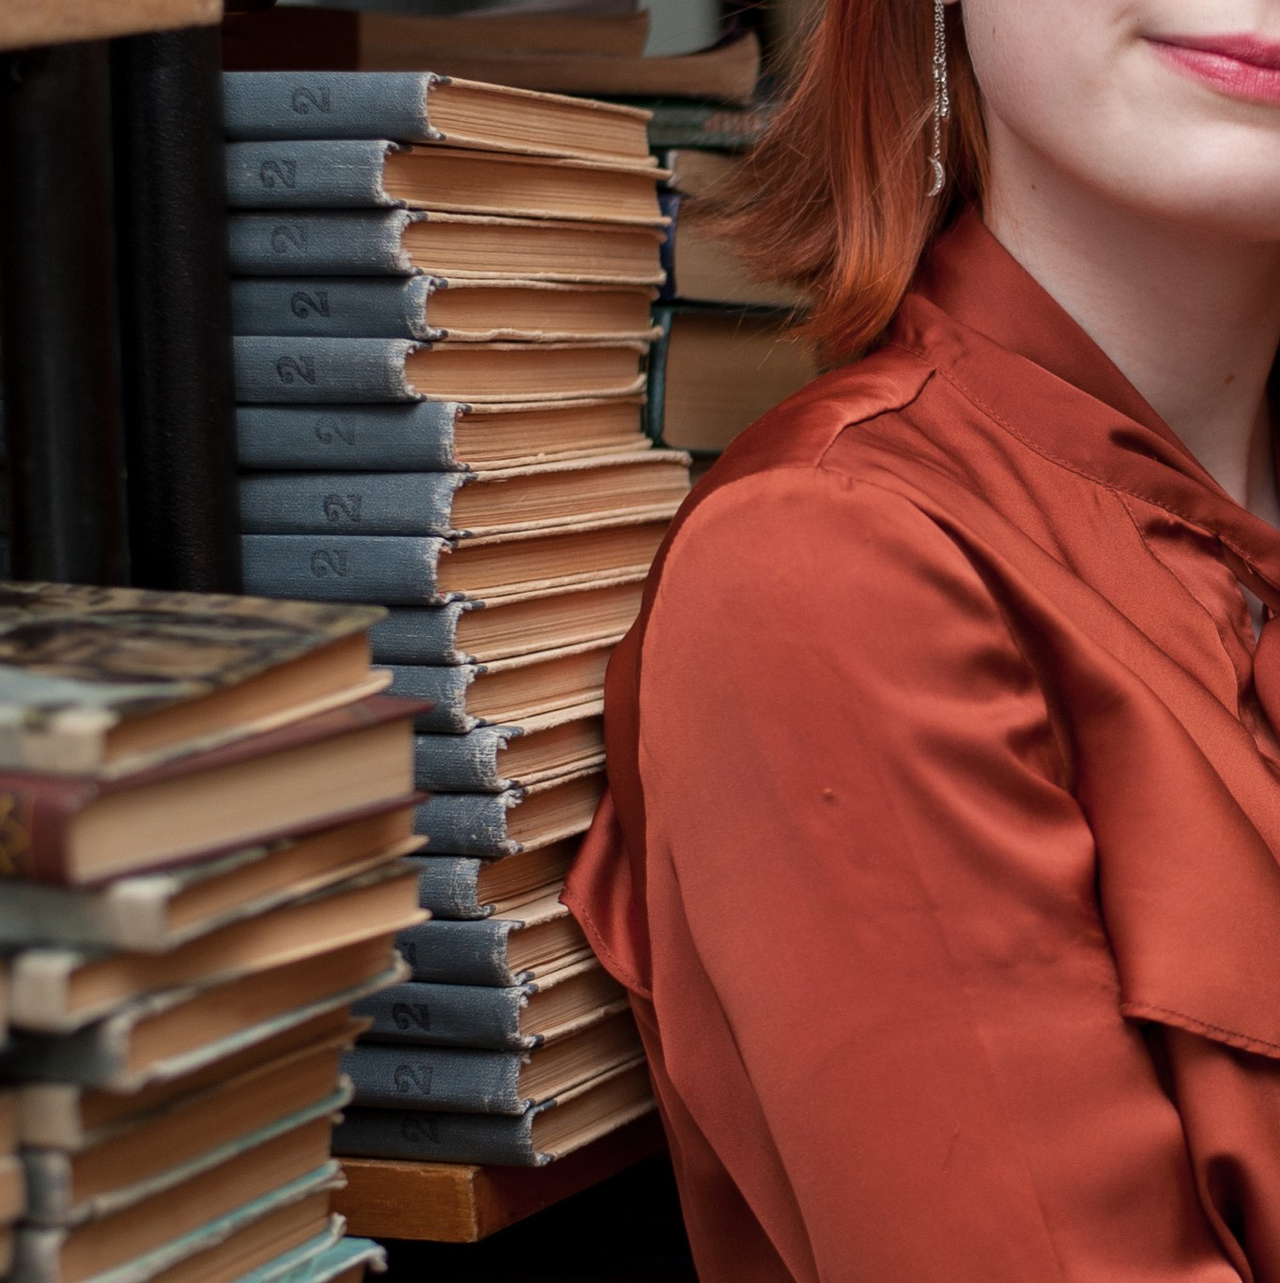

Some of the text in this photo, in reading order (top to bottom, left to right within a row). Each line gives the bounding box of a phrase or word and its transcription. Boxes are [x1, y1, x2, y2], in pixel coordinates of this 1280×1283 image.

[290, 85, 332, 114] 2
[259, 156, 298, 189] 2
[271, 225, 308, 256] 2
[290, 290, 330, 319] 2
[276, 355, 316, 385] 2
[323, 493, 362, 524] 2
[311, 547, 348, 578] 2
[393, 1002, 431, 1032] 2
[394, 1065, 433, 1095] 2
